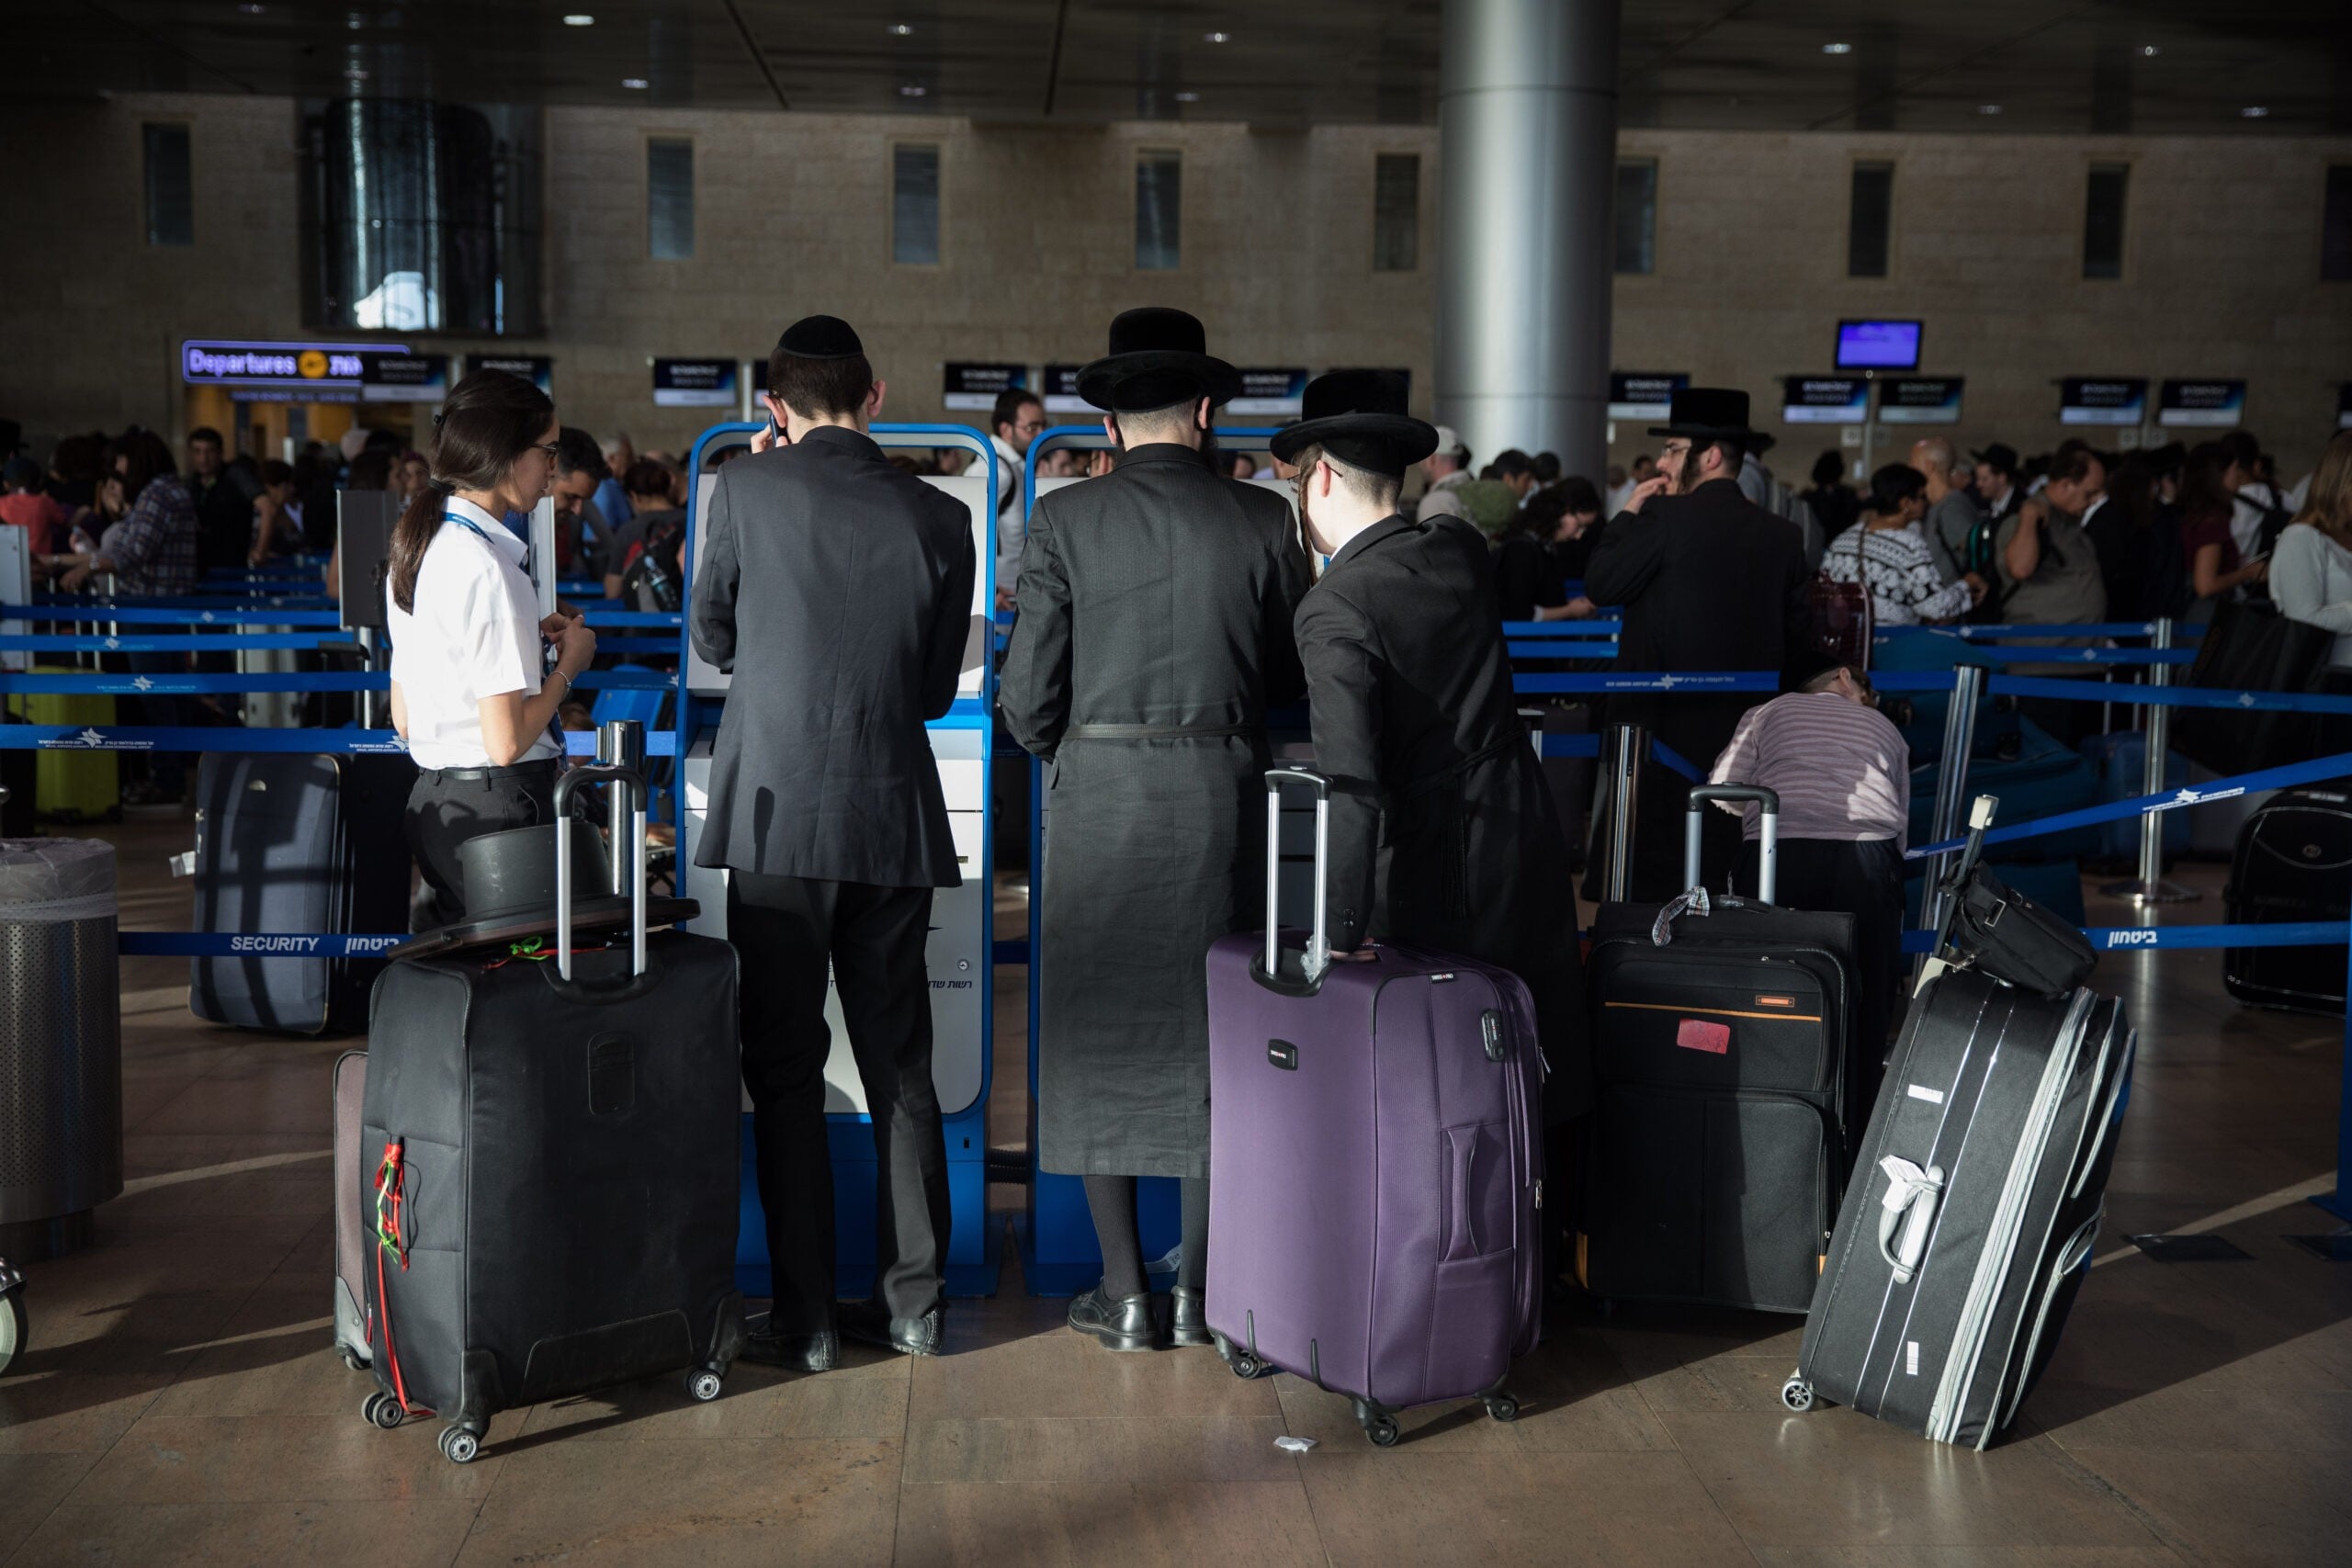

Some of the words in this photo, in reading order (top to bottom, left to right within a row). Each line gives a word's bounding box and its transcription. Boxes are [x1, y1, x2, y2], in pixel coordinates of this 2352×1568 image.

[188, 348, 297, 378] Departures
[231, 936, 319, 951] SECURITY
[2107, 931, 2158, 949] ביטחון
[946, 979, 973, 989] רשות
